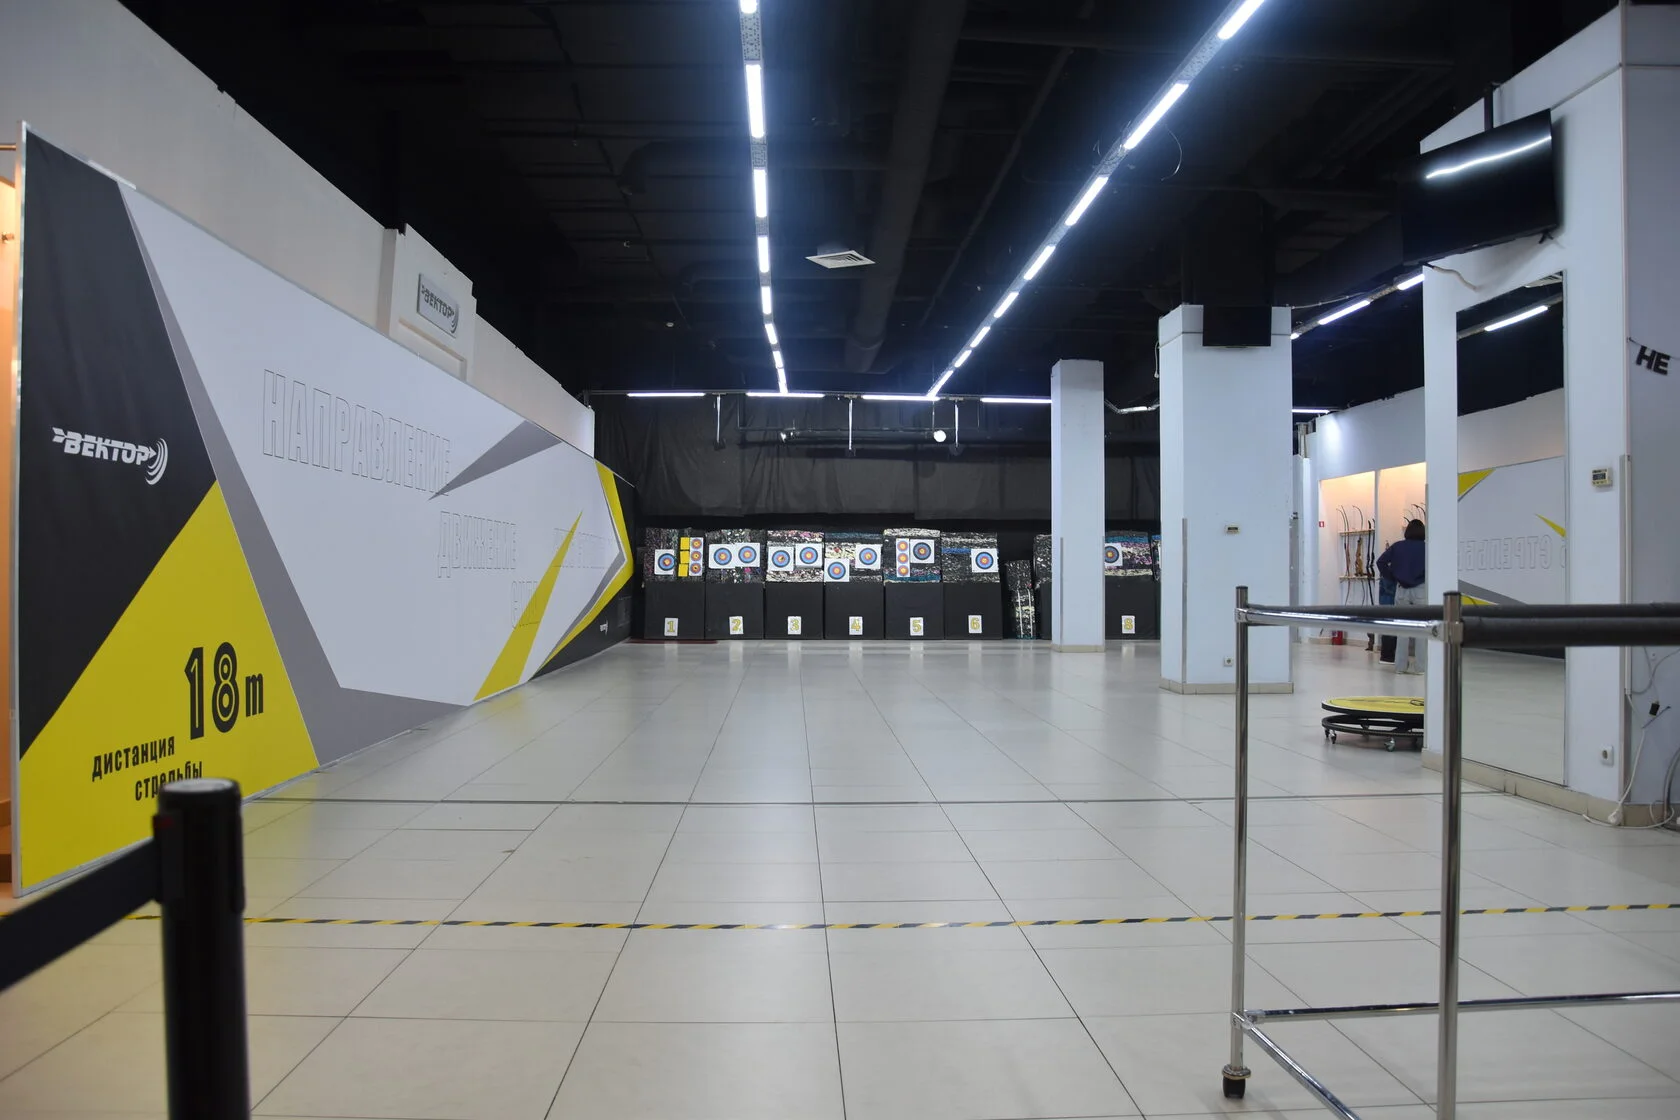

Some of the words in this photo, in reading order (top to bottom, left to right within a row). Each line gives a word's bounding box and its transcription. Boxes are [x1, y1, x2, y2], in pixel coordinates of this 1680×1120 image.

[263, 368, 451, 496] НАПРАВЛЕНИЕ
[64, 431, 150, 466] ВЕКТОР
[437, 511, 516, 578] ДВИЖЕНИЕ
[666, 620, 676, 633] 1
[731, 618, 742, 632] 2
[790, 618, 800, 632] 3
[850, 618, 861, 632] 4
[912, 619, 922, 632] 5
[970, 617, 980, 631] 6
[1123, 618, 1133, 631] 8
[184, 642, 239, 740] 18
[92, 736, 175, 782] дистанция
